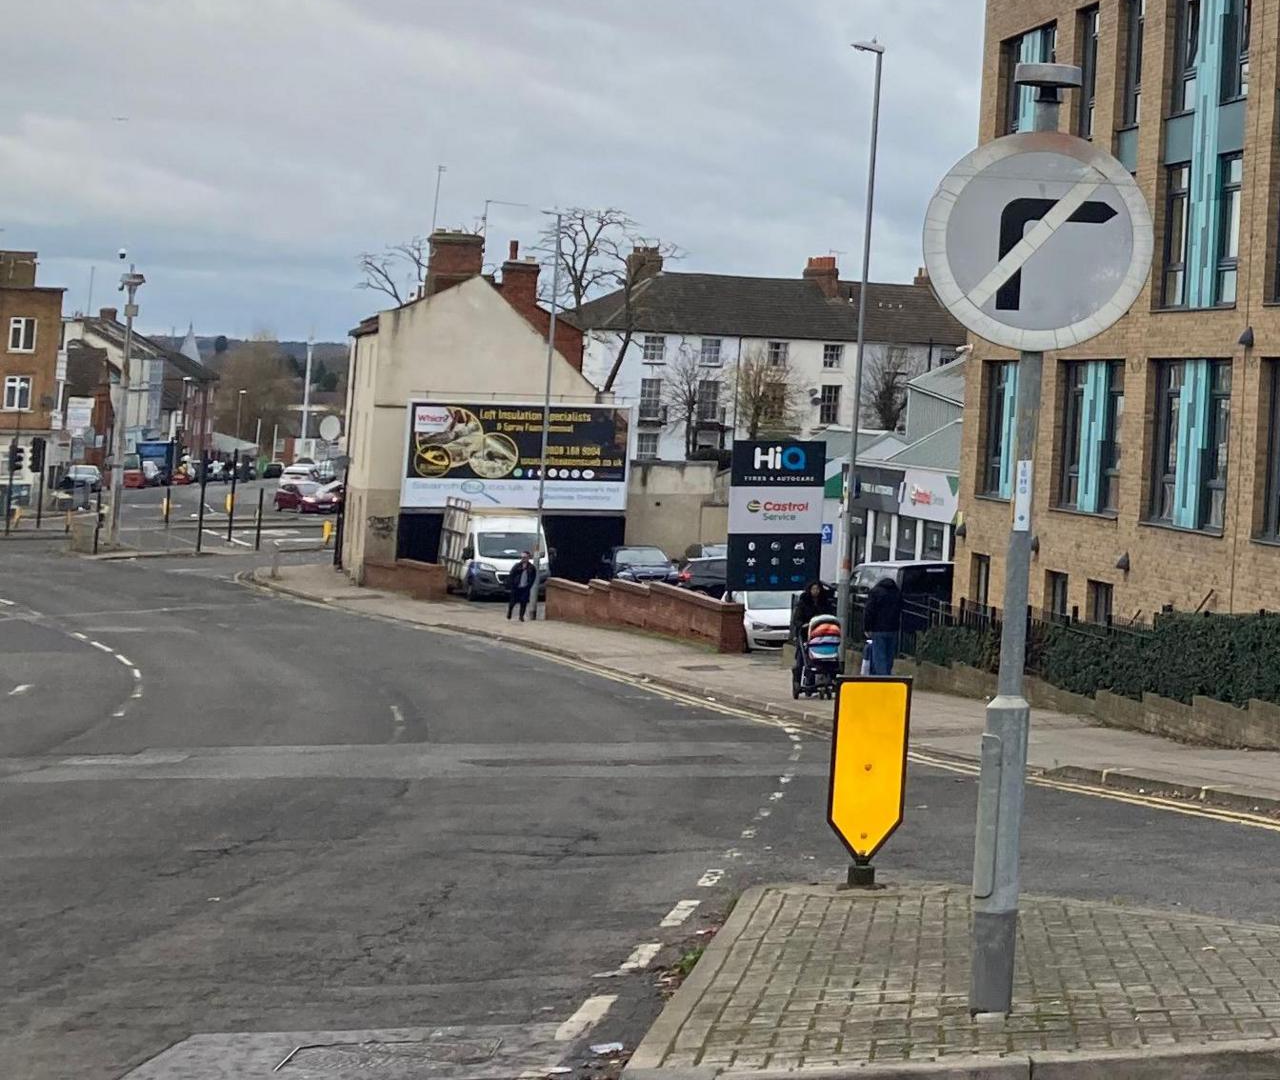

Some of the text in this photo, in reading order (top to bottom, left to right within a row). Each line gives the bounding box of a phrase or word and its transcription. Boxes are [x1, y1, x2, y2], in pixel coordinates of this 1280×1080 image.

[545, 411, 592, 422] pecialists
[754, 446, 807, 471] HiQ
[763, 501, 809, 512] Castrol
[763, 513, 797, 521] Service
